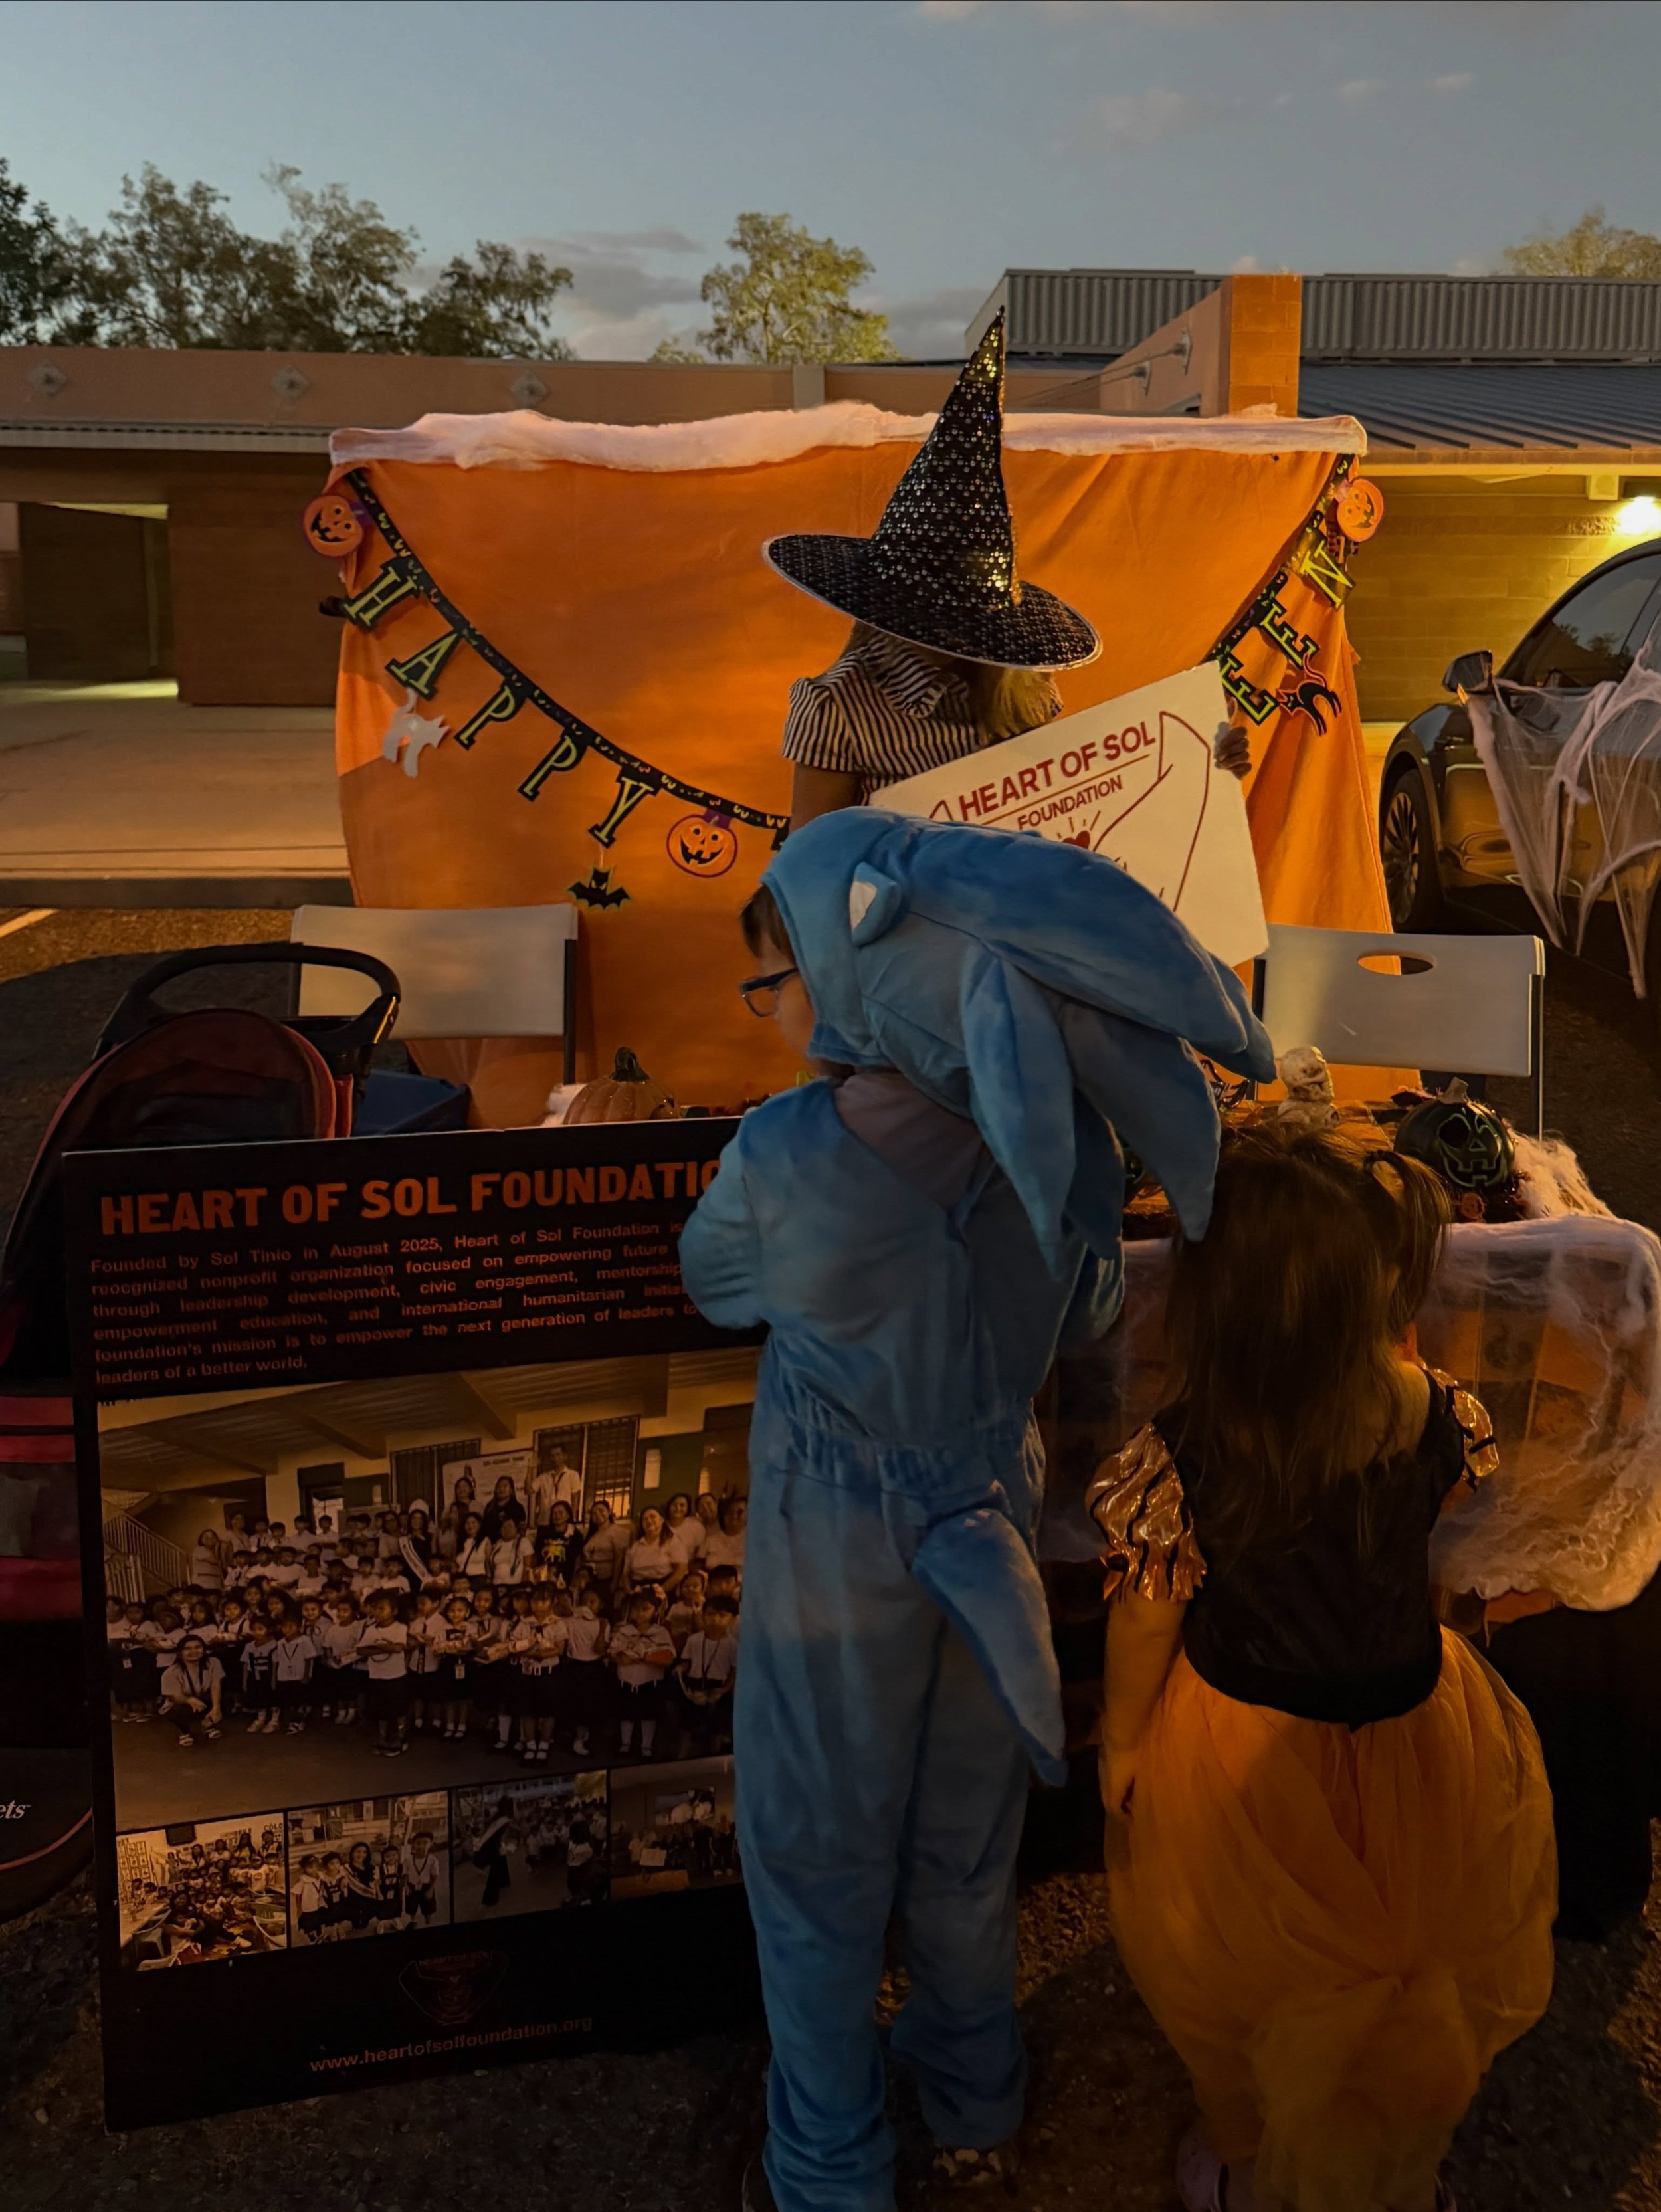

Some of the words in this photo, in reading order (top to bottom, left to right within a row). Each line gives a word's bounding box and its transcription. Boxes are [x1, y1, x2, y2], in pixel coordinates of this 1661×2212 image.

[341, 565, 658, 846] HAPPY
[958, 759, 1054, 821] HEART
[1060, 742, 1098, 778] OF
[1103, 722, 1156, 761] SOL
[1017, 775, 1123, 830] FOUNDATION
[101, 1188, 267, 1235] HEART
[282, 1183, 347, 1224] OF
[361, 1177, 458, 1219] SOL
[91, 1255, 167, 1274] Founded
[179, 1254, 199, 1270] by
[210, 1251, 239, 1266] Sol
[302, 1246, 319, 1260] in
[330, 1240, 389, 1258] August
[399, 1237, 443, 1252] 2025,
[454, 1233, 499, 1249] Heart
[510, 1231, 527, 1245] of
[536, 1228, 562, 1243] Sol
[572, 1223, 660, 1240] Foundation
[92, 1276, 189, 1296] recognized
[200, 1270, 278, 1290] nonprofit
[290, 1263, 394, 1284] organization
[405, 1257, 472, 1274] focused
[482, 1255, 504, 1268] on
[514, 1247, 612, 1265] empowering
[623, 1243, 668, 1257] future
[93, 1300, 160, 1318] through
[179, 1294, 269, 1313] leadership
[287, 1284, 401, 1304] development,
[419, 1280, 457, 1294] civic
[474, 1270, 578, 1290] engagement,
[93, 1318, 218, 1340] empowerment
[239, 1312, 328, 1330] education,
[348, 1307, 380, 1322] and
[401, 1297, 503, 1316] international
[522, 1288, 625, 1307] humanitarian
[94, 1340, 201, 1362] foundation's
[211, 1336, 276, 1354] mission
[286, 1334, 300, 1348] is
[309, 1332, 327, 1348] to
[336, 1327, 413, 1344] empower
[420, 1322, 448, 1337] the
[457, 1319, 492, 1334] next
[501, 1312, 586, 1333] generation
[593, 1308, 610, 1323] of
[617, 1305, 674, 1320] leaders
[96, 1367, 159, 1385] leaders
[165, 1365, 181, 1380] of
[186, 1367, 197, 1378] a
[201, 1360, 252, 1377] better
[255, 1355, 308, 1372] world.
[310, 2017, 593, 2072] www.heartofsolfoundation.org
